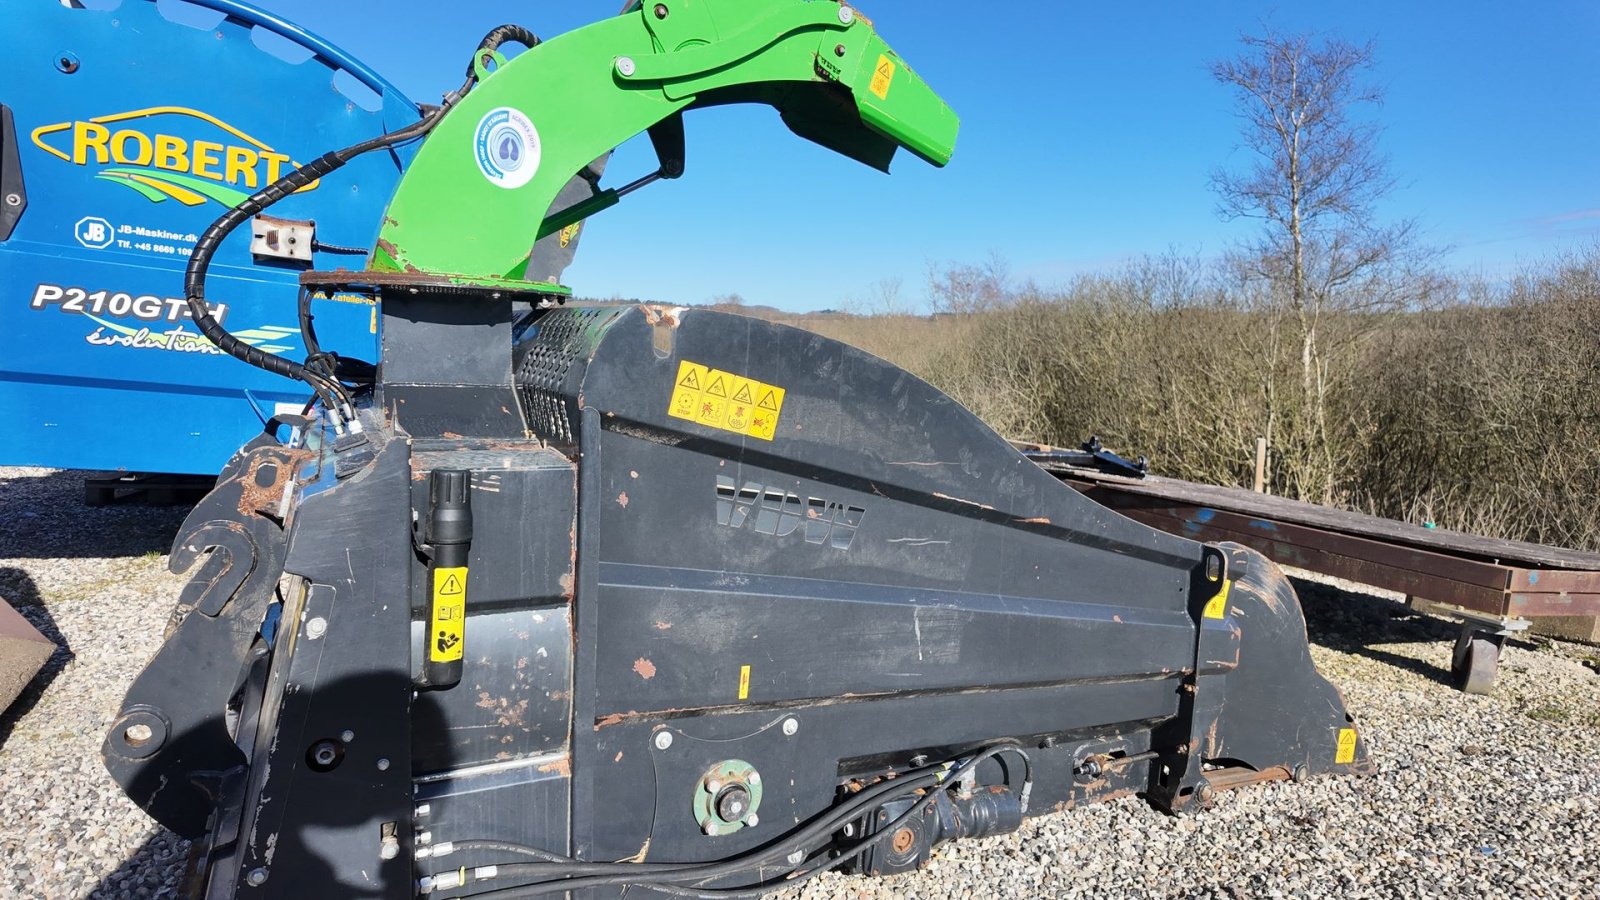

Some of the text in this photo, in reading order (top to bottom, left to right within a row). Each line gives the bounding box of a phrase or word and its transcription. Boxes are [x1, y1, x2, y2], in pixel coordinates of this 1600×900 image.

[73, 121, 290, 189] ROBERT
[83, 223, 105, 241] JB
[117, 224, 198, 243] JB-Maskiner.dk
[117, 240, 132, 249] Tlf.
[134, 243, 151, 251] +45
[177, 247, 193, 256] 109
